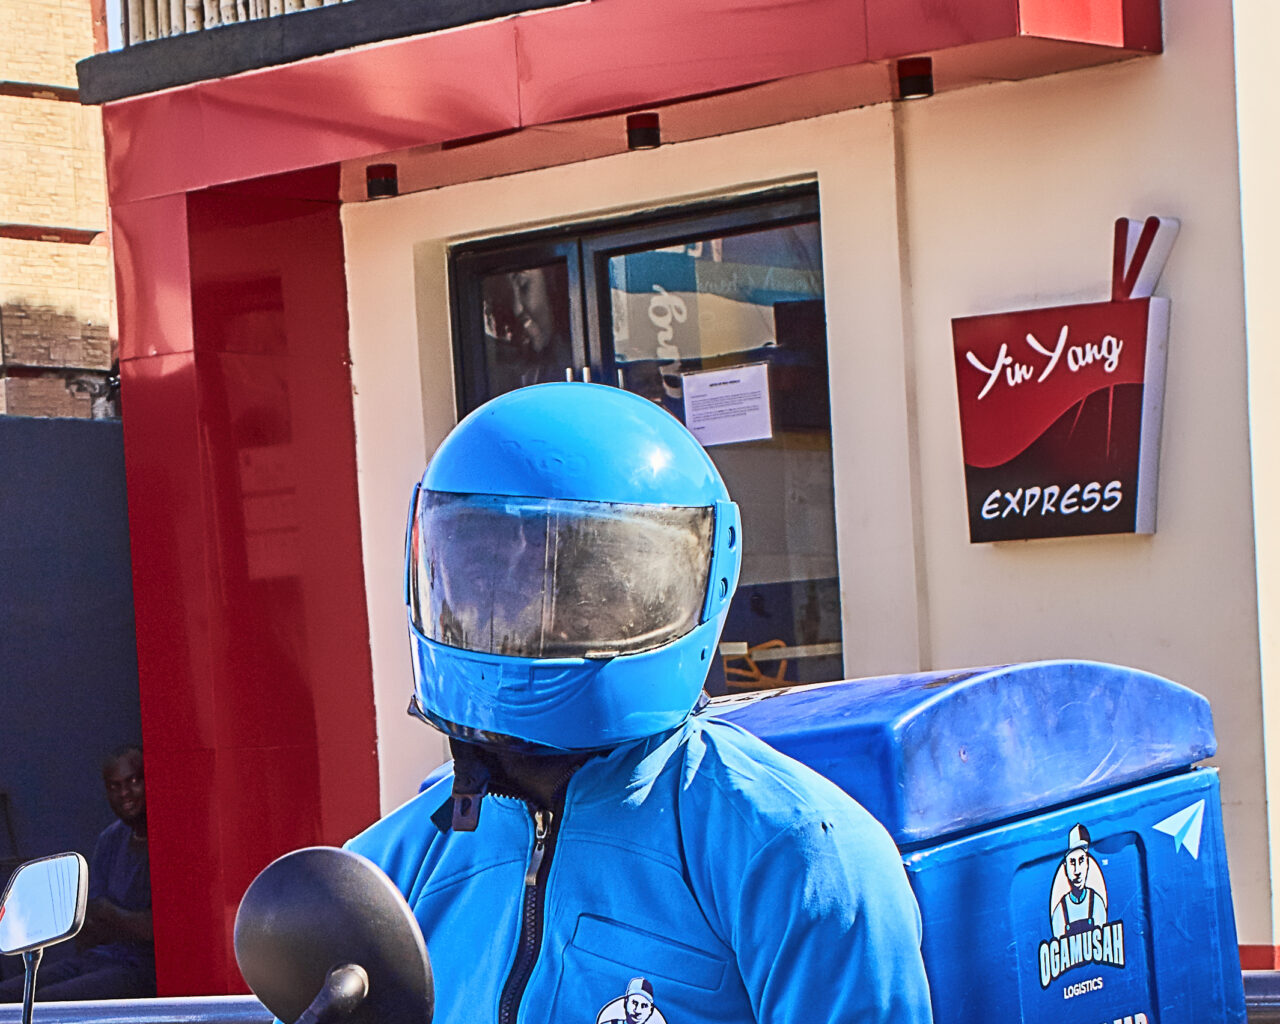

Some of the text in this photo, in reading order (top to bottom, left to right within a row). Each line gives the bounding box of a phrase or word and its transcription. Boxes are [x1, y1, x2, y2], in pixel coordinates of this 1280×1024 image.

[966, 325, 1123, 400] Yin Yang
[981, 480, 1123, 520] EXPRESS
[1039, 926, 1124, 987] OGAMUSAH
[1063, 977, 1104, 1000] LOGISTICS
